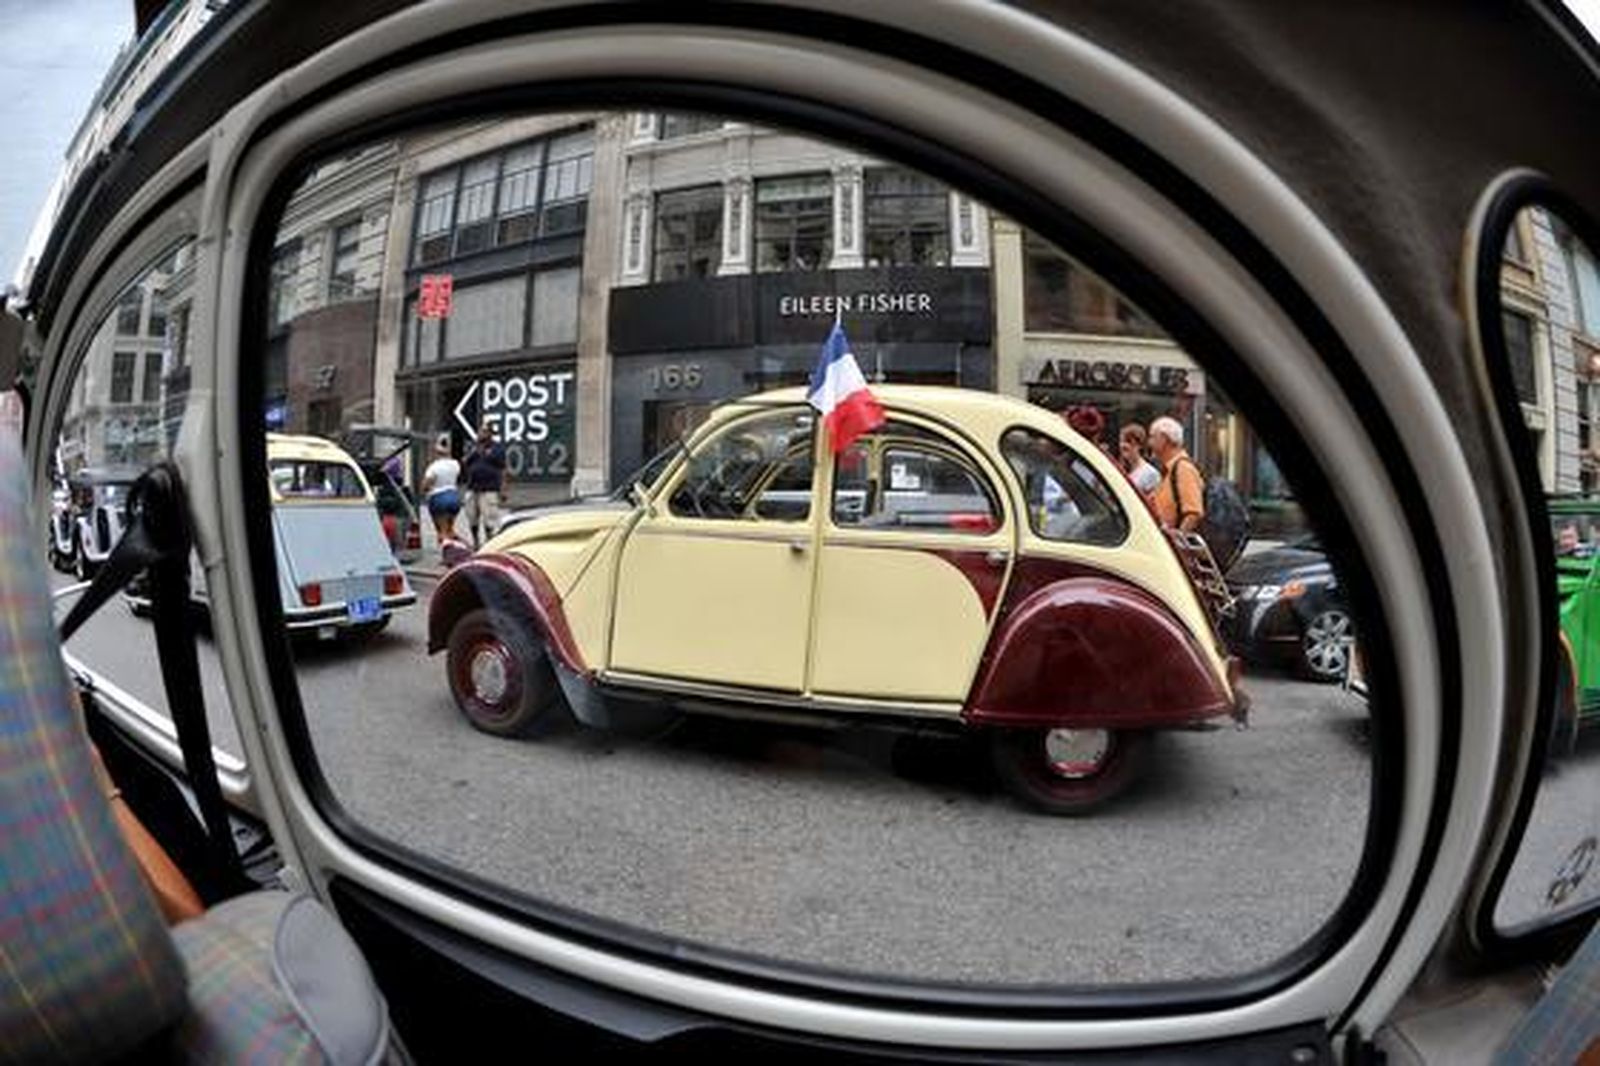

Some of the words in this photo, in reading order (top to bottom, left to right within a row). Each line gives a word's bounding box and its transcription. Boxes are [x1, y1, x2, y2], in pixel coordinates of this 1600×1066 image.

[779, 295, 851, 316] EILEEN
[858, 293, 932, 313] FISHER
[649, 363, 703, 390] 166
[1039, 358, 1190, 390] AEROSOLES
[482, 372, 574, 410] POST
[504, 442, 569, 477] 012
